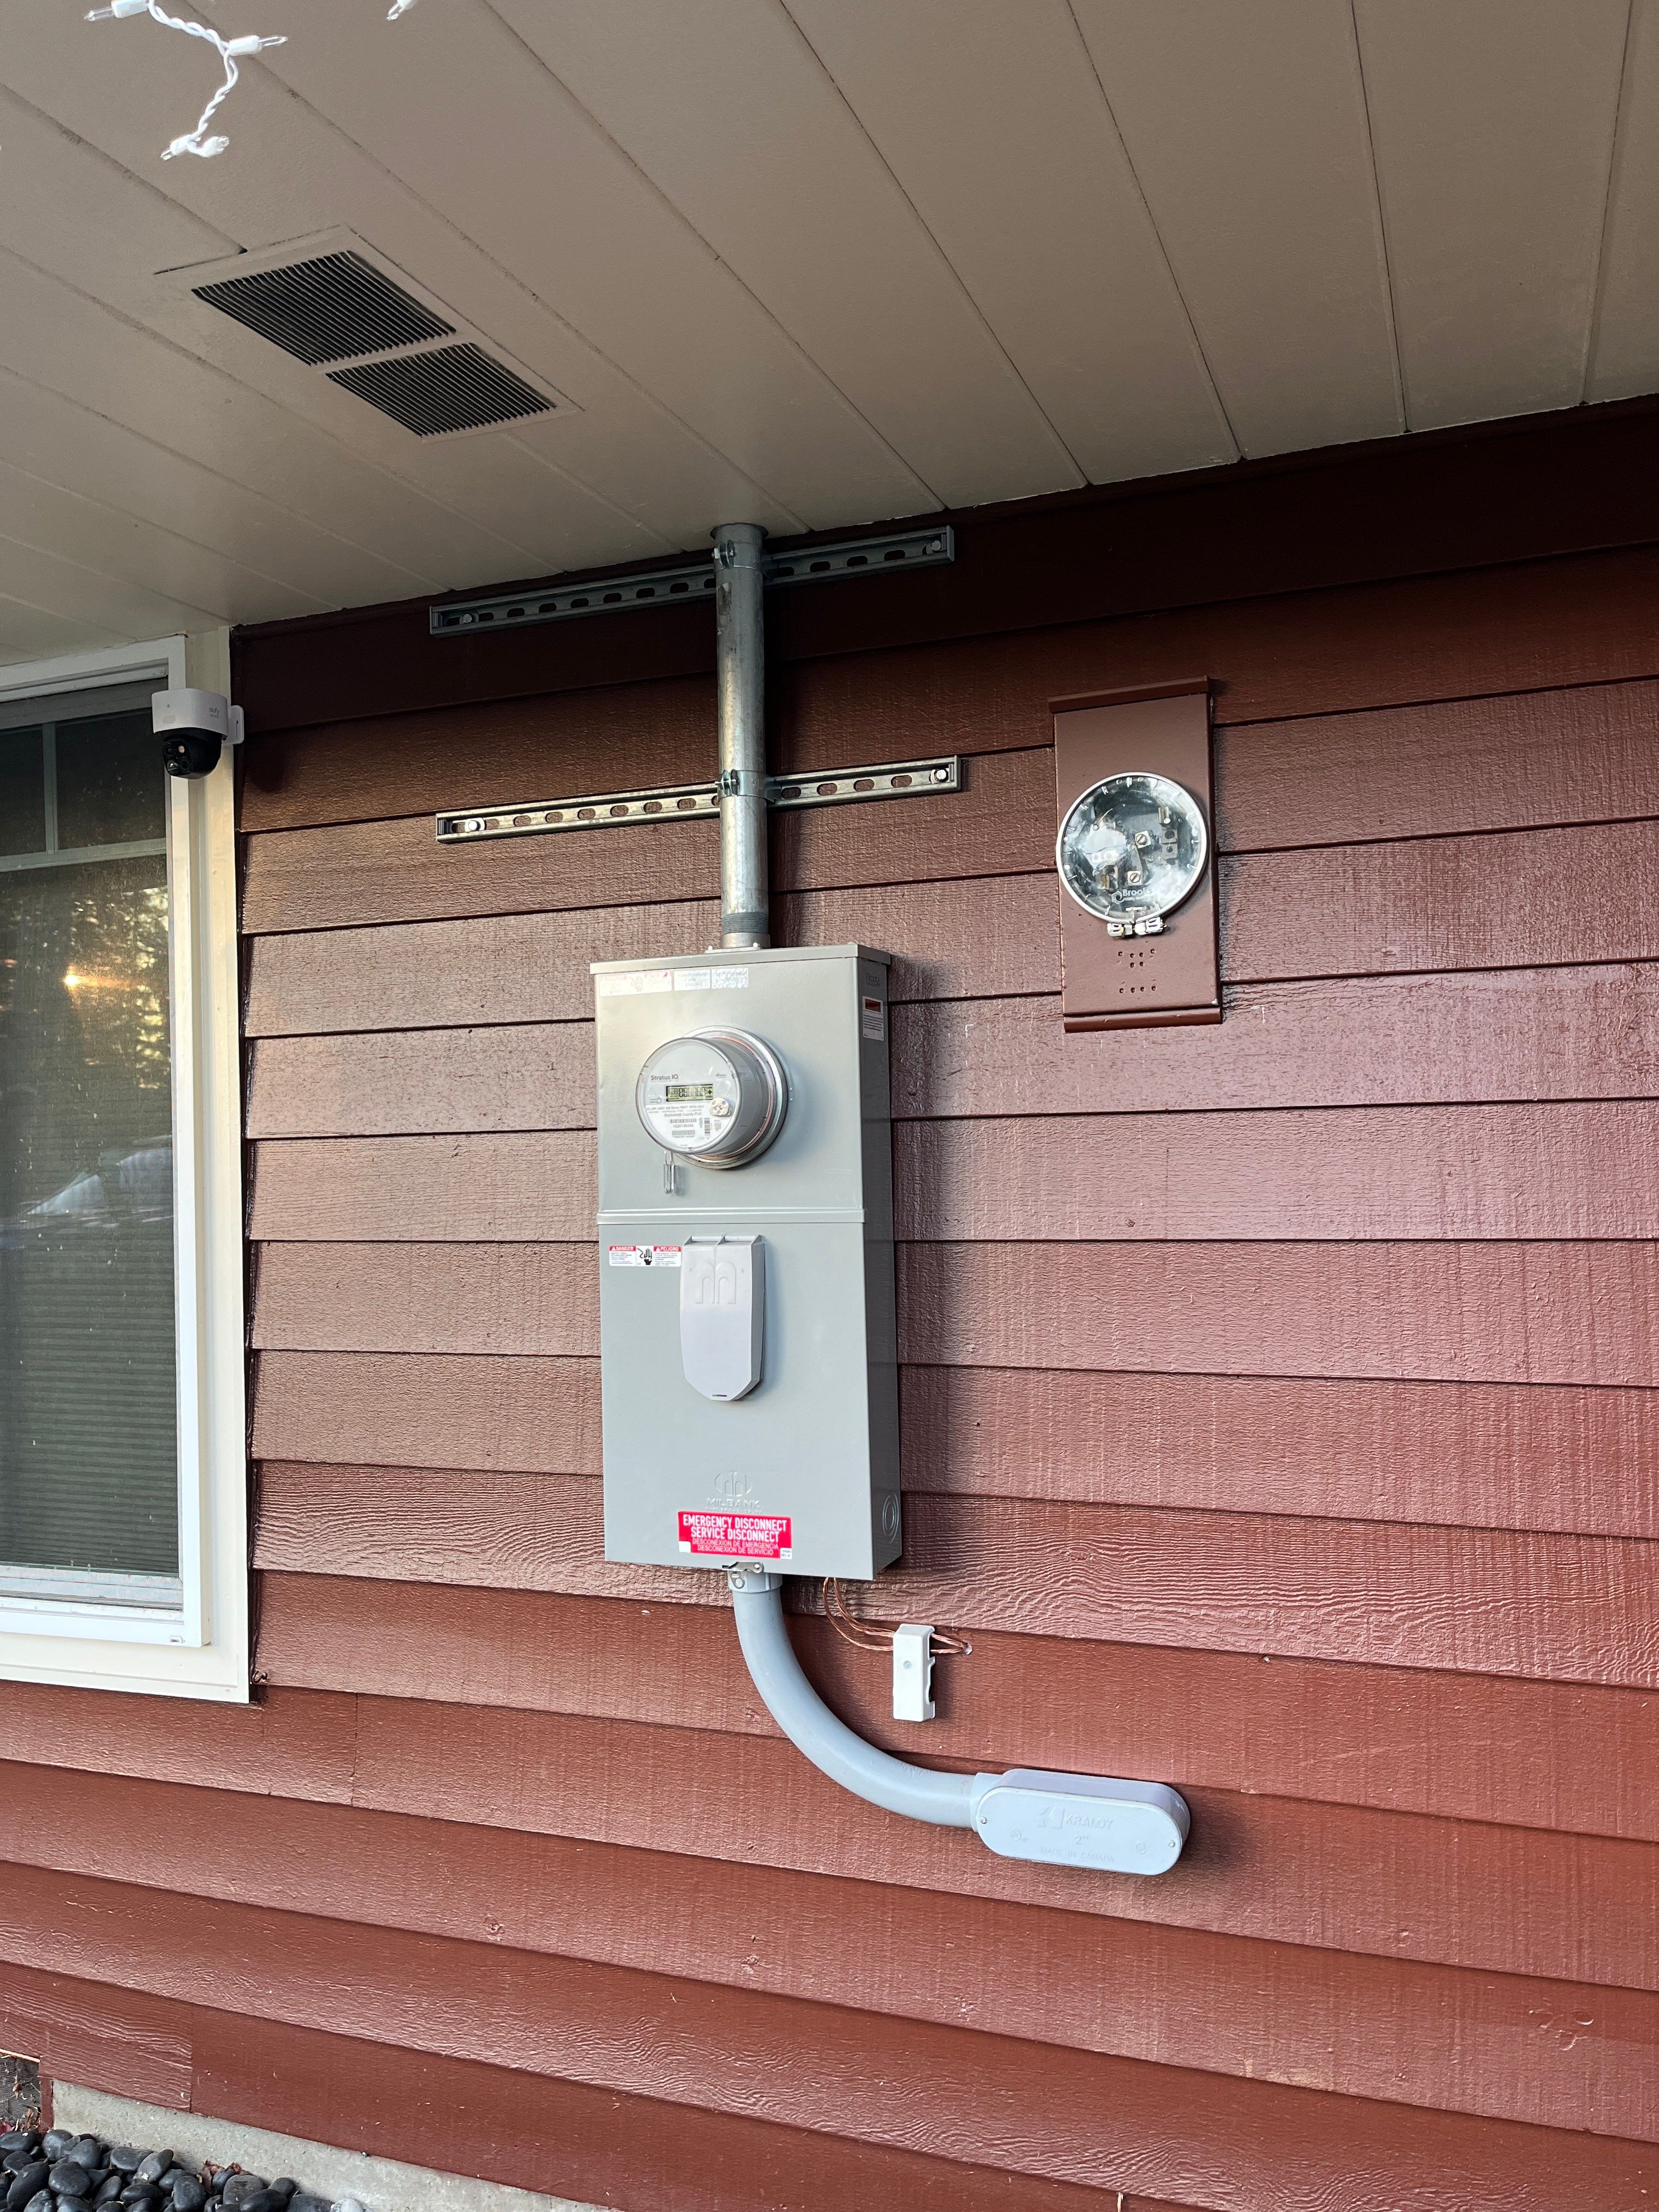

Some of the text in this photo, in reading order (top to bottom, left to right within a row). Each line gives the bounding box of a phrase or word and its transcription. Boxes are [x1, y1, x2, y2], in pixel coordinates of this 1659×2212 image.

[706, 1497, 761, 1508] MILBANK
[683, 1514, 787, 1532] EMERGENCY DISCONNECT
[691, 1526, 780, 1543] SERVICE DISCONNECT
[1066, 1814, 1114, 1830] KRALOY
[1040, 1846, 1115, 1863] MADE IN CANADA
